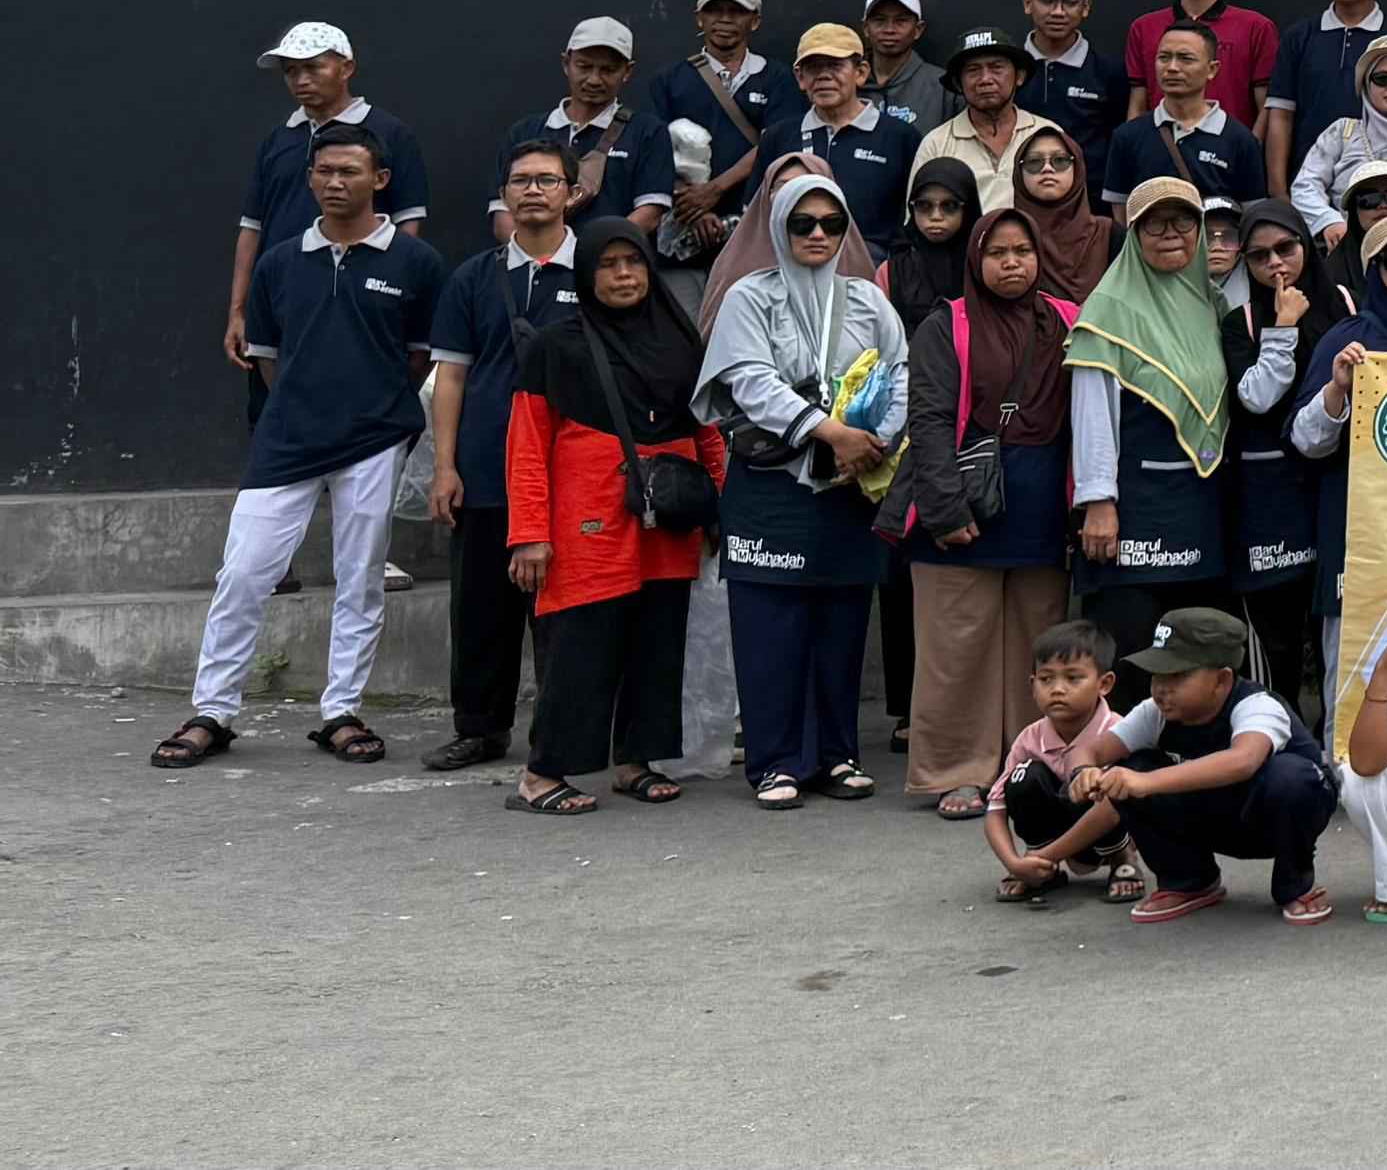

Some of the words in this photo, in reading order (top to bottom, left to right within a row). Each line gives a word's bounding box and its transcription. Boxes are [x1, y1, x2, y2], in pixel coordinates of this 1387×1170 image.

[728, 535, 763, 551] Darul
[1120, 538, 1162, 553] Darul
[1252, 541, 1285, 558] Darul
[738, 549, 805, 570] Mujahadah
[1132, 547, 1201, 567] Mujahadah
